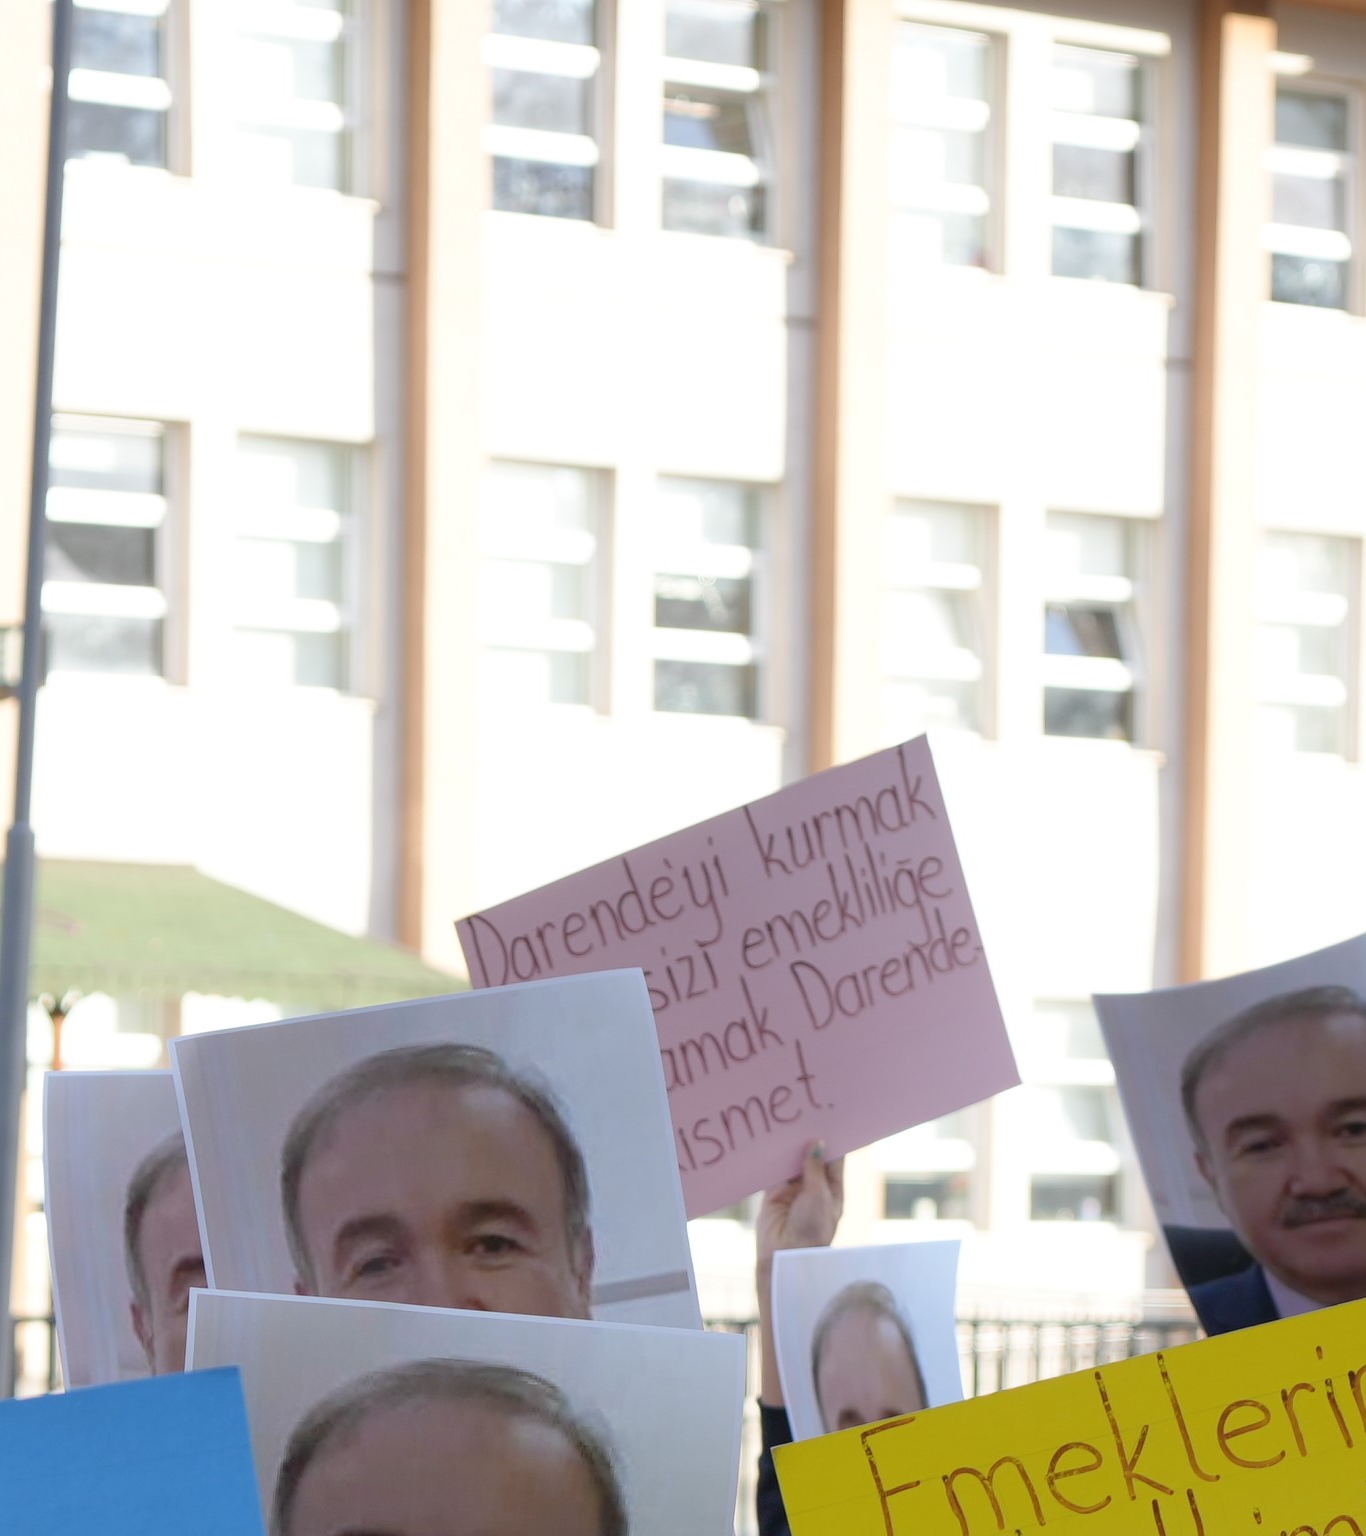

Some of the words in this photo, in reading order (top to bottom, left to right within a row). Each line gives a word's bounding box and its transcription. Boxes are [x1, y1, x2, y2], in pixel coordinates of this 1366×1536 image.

[742, 744, 938, 878] kurmak
[644, 947, 720, 1013] sizi
[741, 841, 954, 970] emekliliğe
[660, 974, 784, 1092] amak
[677, 1038, 835, 1171] ısmet.
